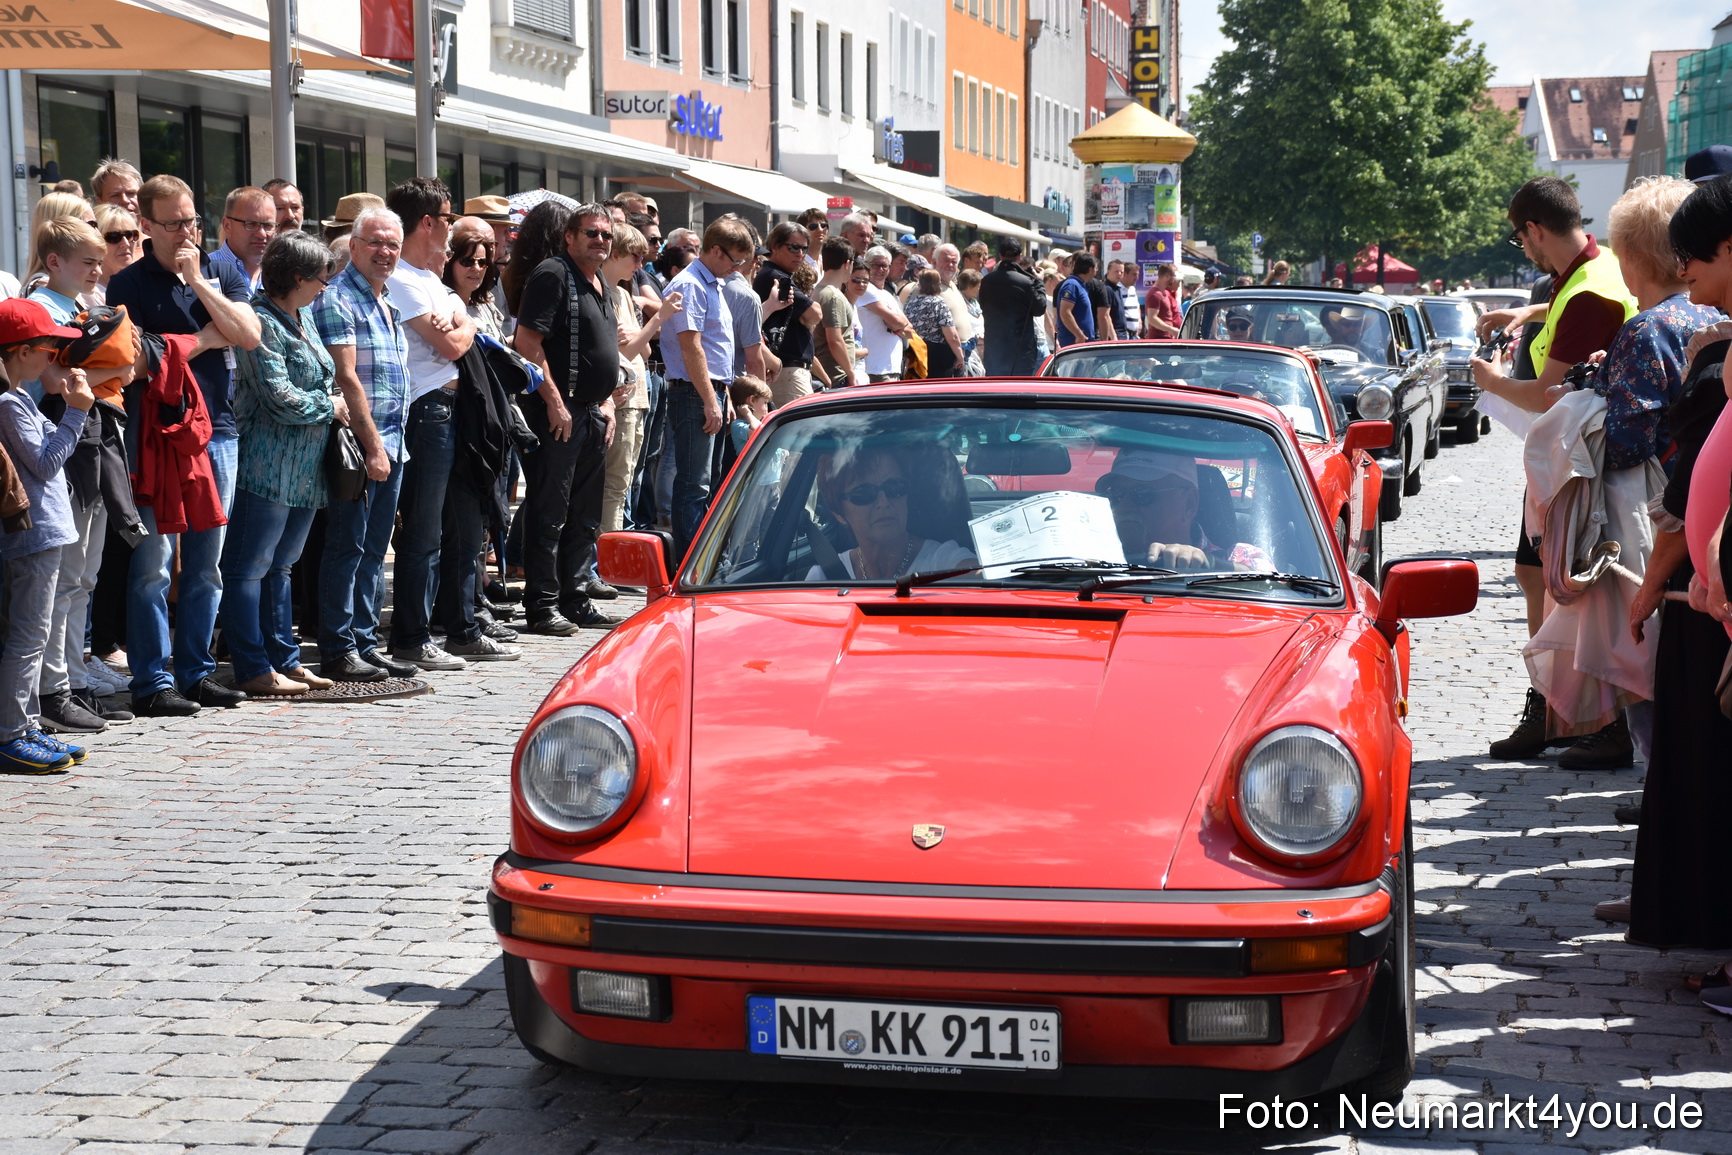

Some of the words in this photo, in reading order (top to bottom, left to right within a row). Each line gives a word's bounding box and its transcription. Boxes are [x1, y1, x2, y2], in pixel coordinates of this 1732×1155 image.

[1041, 506, 1059, 522] 2
[1029, 1018, 1050, 1032] 04
[757, 1031, 769, 1044] D
[779, 1005, 836, 1051] NM
[871, 1010, 927, 1056] KK
[941, 1015, 1024, 1061] 911
[1031, 1050, 1051, 1063] 10
[843, 1062, 962, 1075] www.porsche-ingolstadt.de
